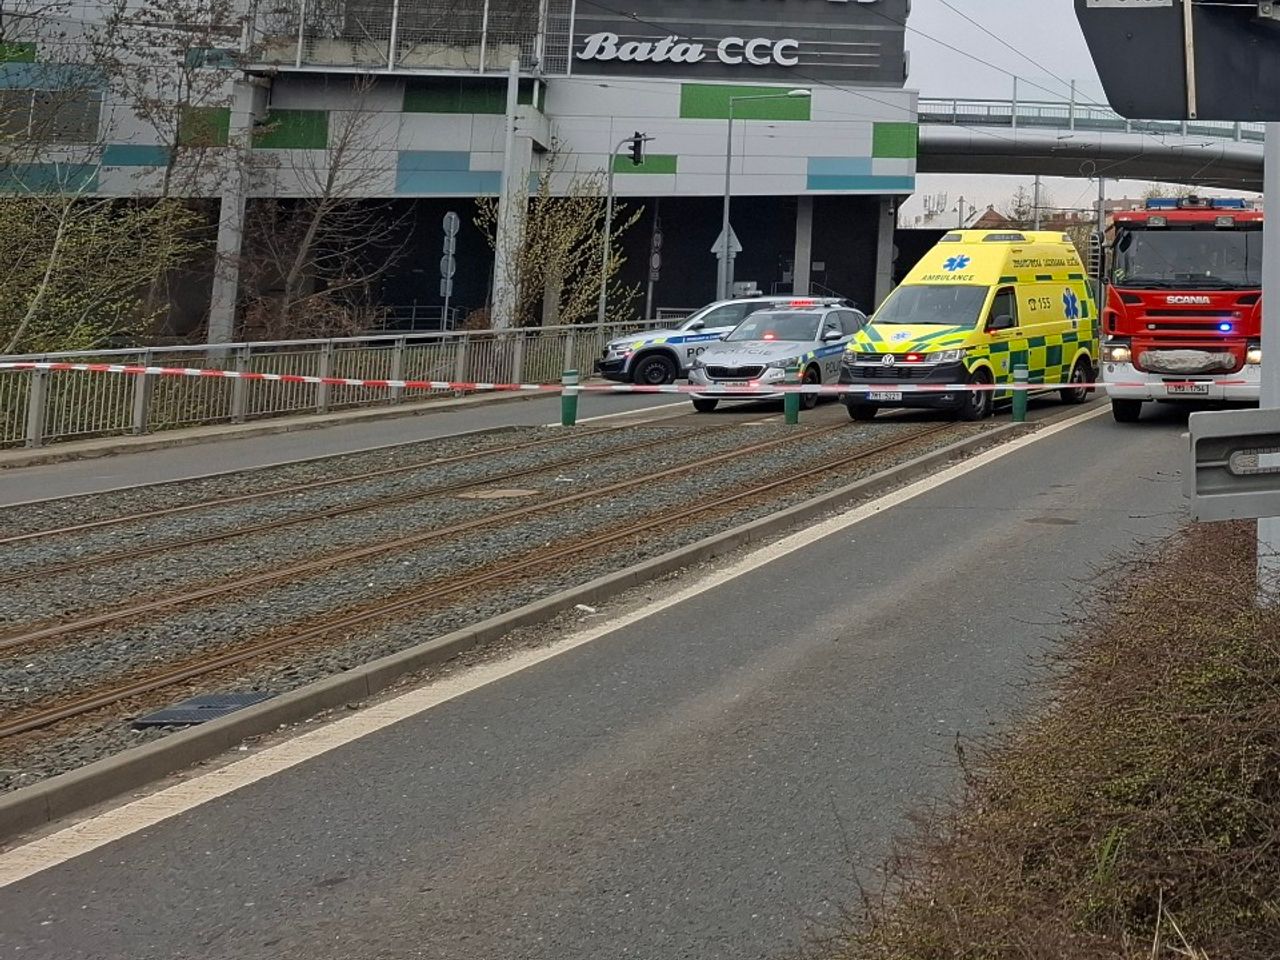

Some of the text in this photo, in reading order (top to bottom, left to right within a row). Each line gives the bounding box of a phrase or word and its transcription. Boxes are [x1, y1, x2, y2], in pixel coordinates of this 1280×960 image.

[717, 37, 799, 67] CCC
[921, 273, 975, 281] AMBULANCE
[1038, 297, 1051, 310] 155
[1166, 295, 1211, 304] SCANIA
